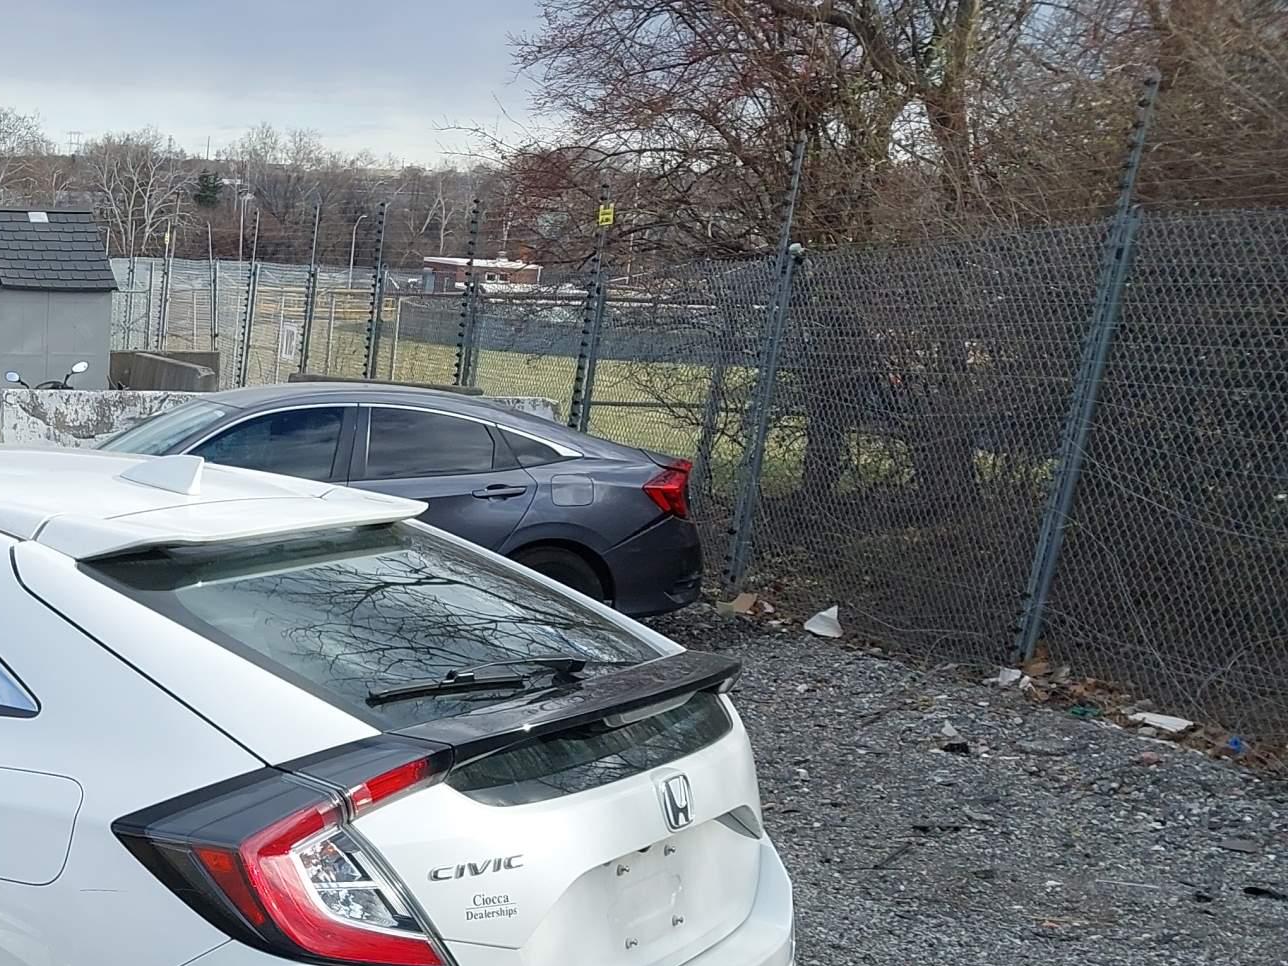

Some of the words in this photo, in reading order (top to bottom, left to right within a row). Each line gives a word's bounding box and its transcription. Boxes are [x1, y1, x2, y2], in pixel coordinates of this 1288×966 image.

[429, 855, 523, 881] CIVIC
[473, 893, 509, 906] Ciocca
[466, 906, 517, 921] Dealerships
